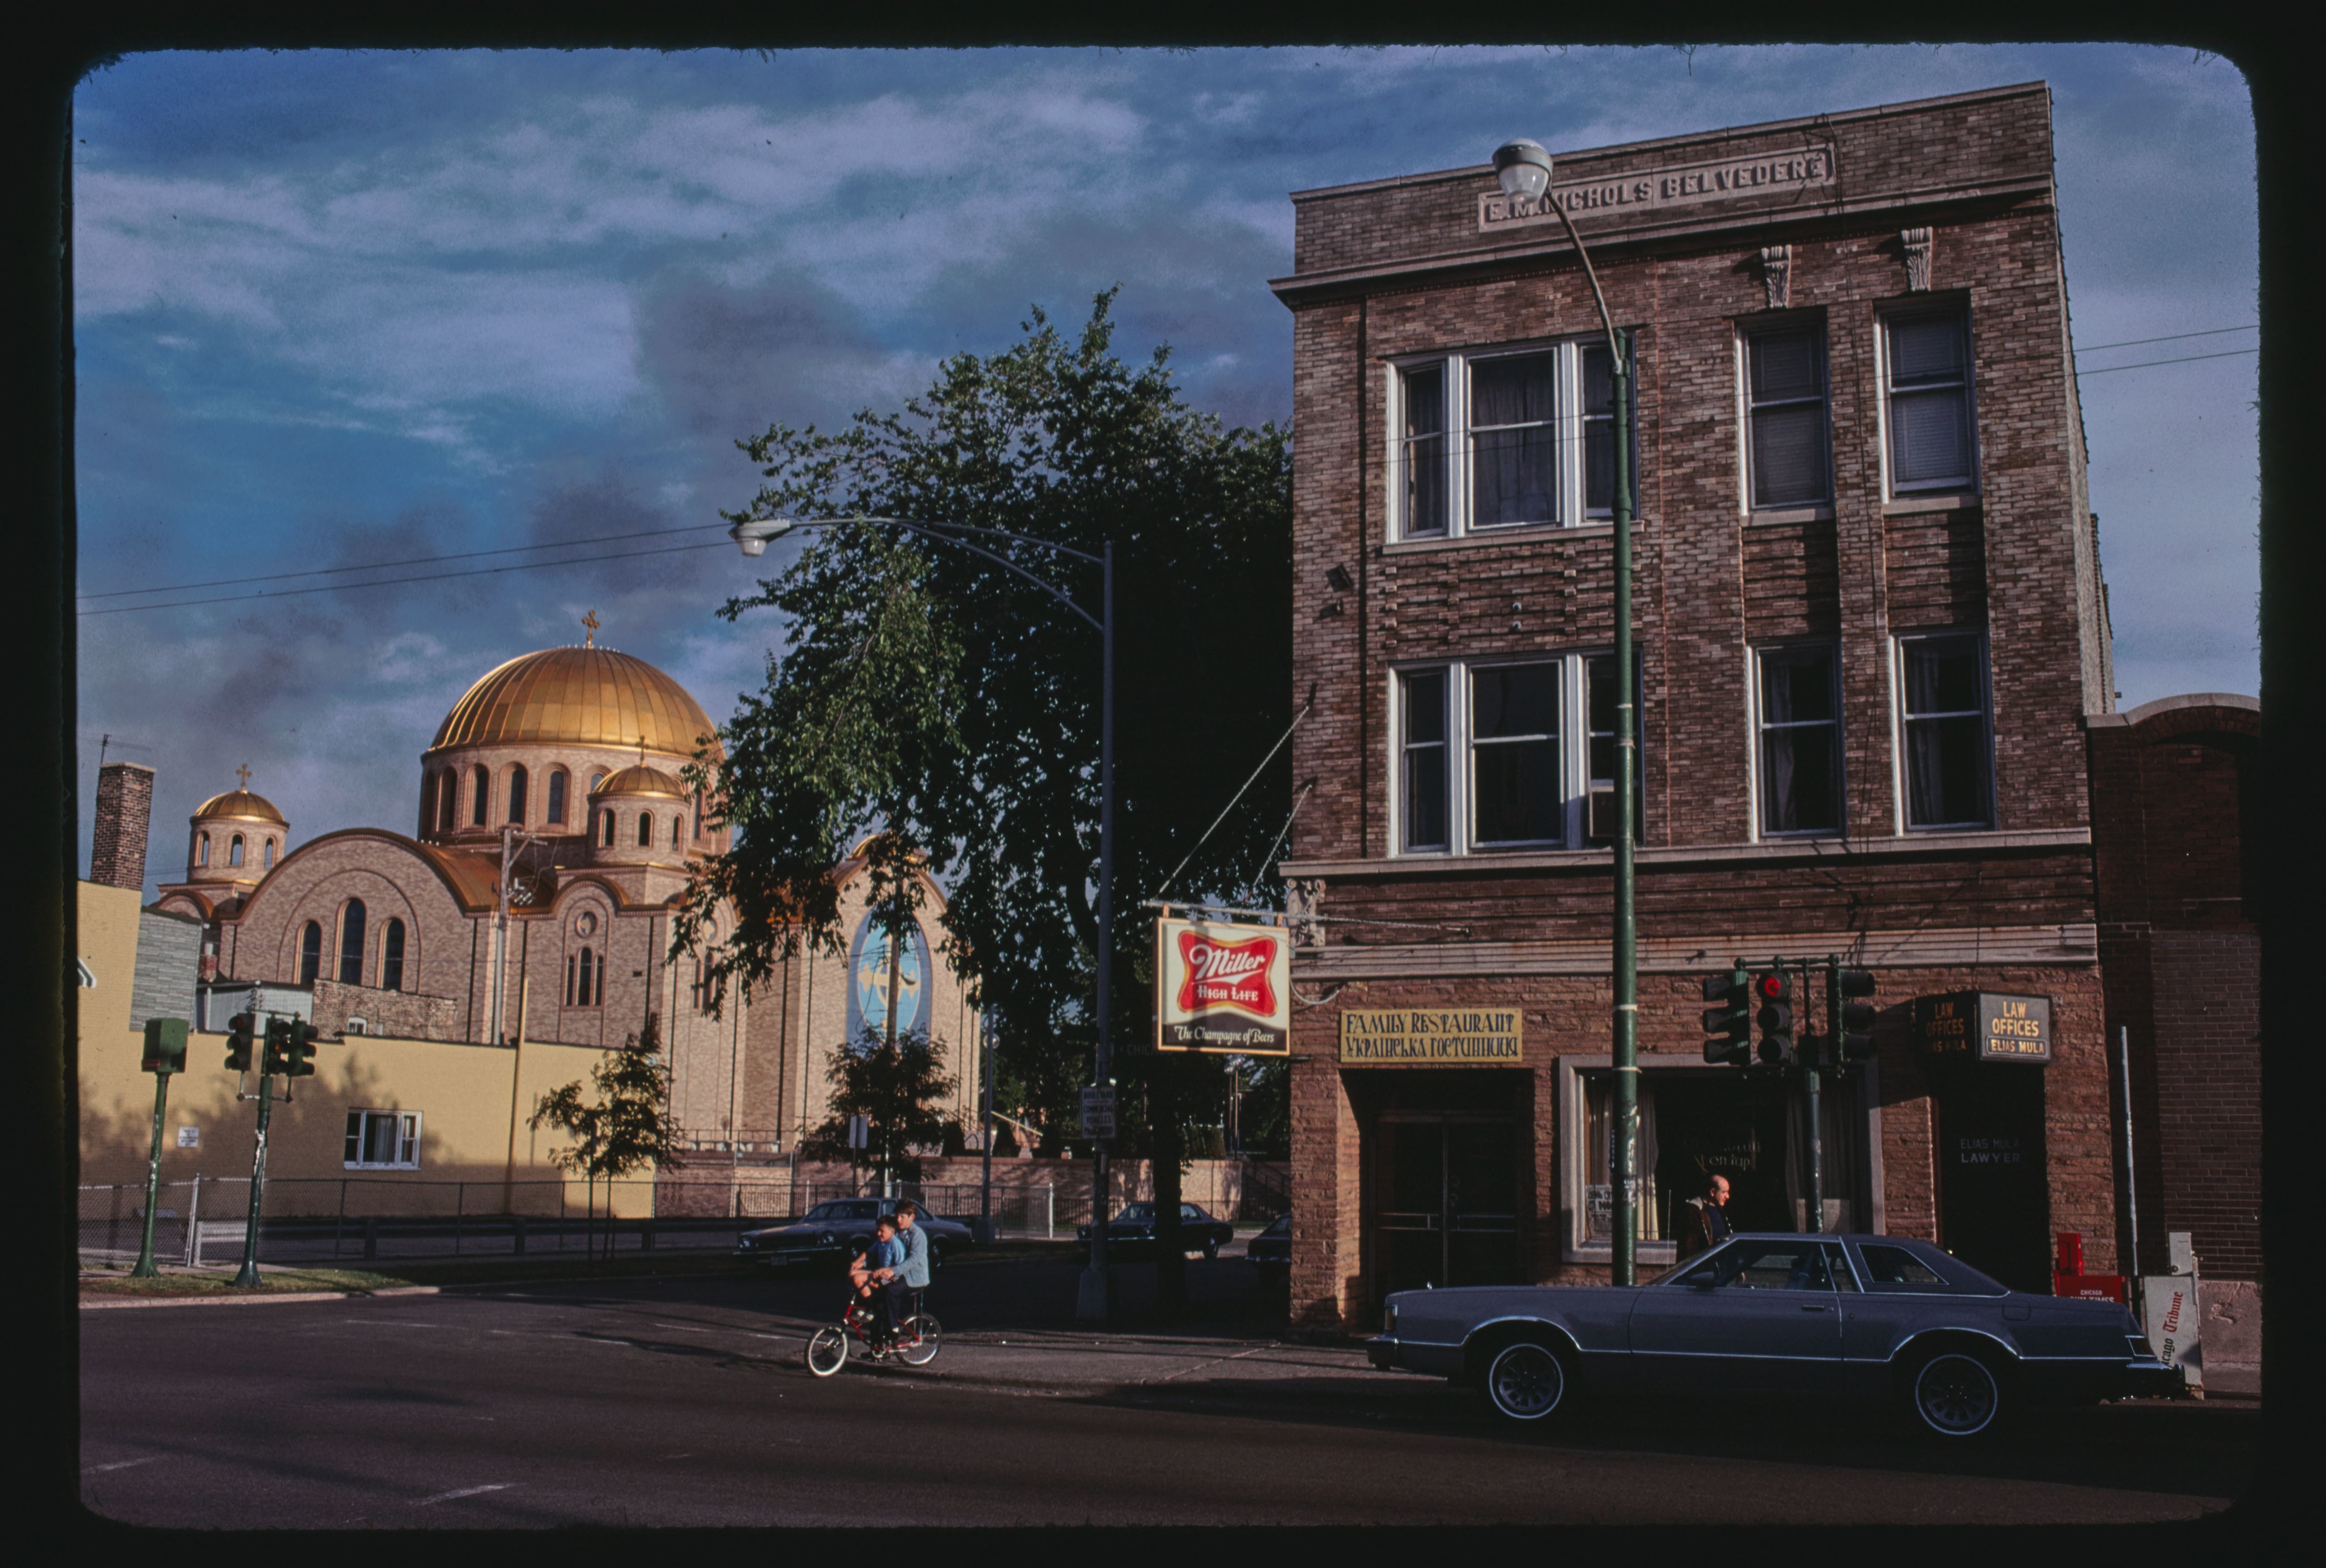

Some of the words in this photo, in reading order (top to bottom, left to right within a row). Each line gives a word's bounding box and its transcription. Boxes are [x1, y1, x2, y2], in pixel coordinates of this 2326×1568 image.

[1666, 153, 1825, 196] BELVEDERE
[1189, 944, 1265, 980] Miller
[1197, 985, 1228, 999] HIGH
[1231, 986, 1259, 1001] LIFE
[1934, 1001, 1954, 1020] LAW
[2003, 1001, 2027, 1018] LAW
[1346, 1014, 1407, 1033] FAMILY
[1411, 1012, 1514, 1033] RESTAURANT
[1925, 1017, 1965, 1037] OFFICES
[1992, 1018, 2039, 1037] OFFICES
[1174, 1026, 1192, 1041] The
[1194, 1027, 1242, 1046] Champagne
[1242, 1028, 1253, 1046] of
[1250, 1028, 1275, 1043] Beers
[1990, 1038, 2015, 1053] ELIAS
[2019, 1041, 2044, 1054] MULA
[1960, 1138, 1988, 1149] ELIAS
[1993, 1138, 2020, 1149] MULA
[1961, 1152, 2021, 1163] LAWYER
[2162, 1291, 2183, 1333] Tribune
[2160, 1337, 2176, 1366] icago
